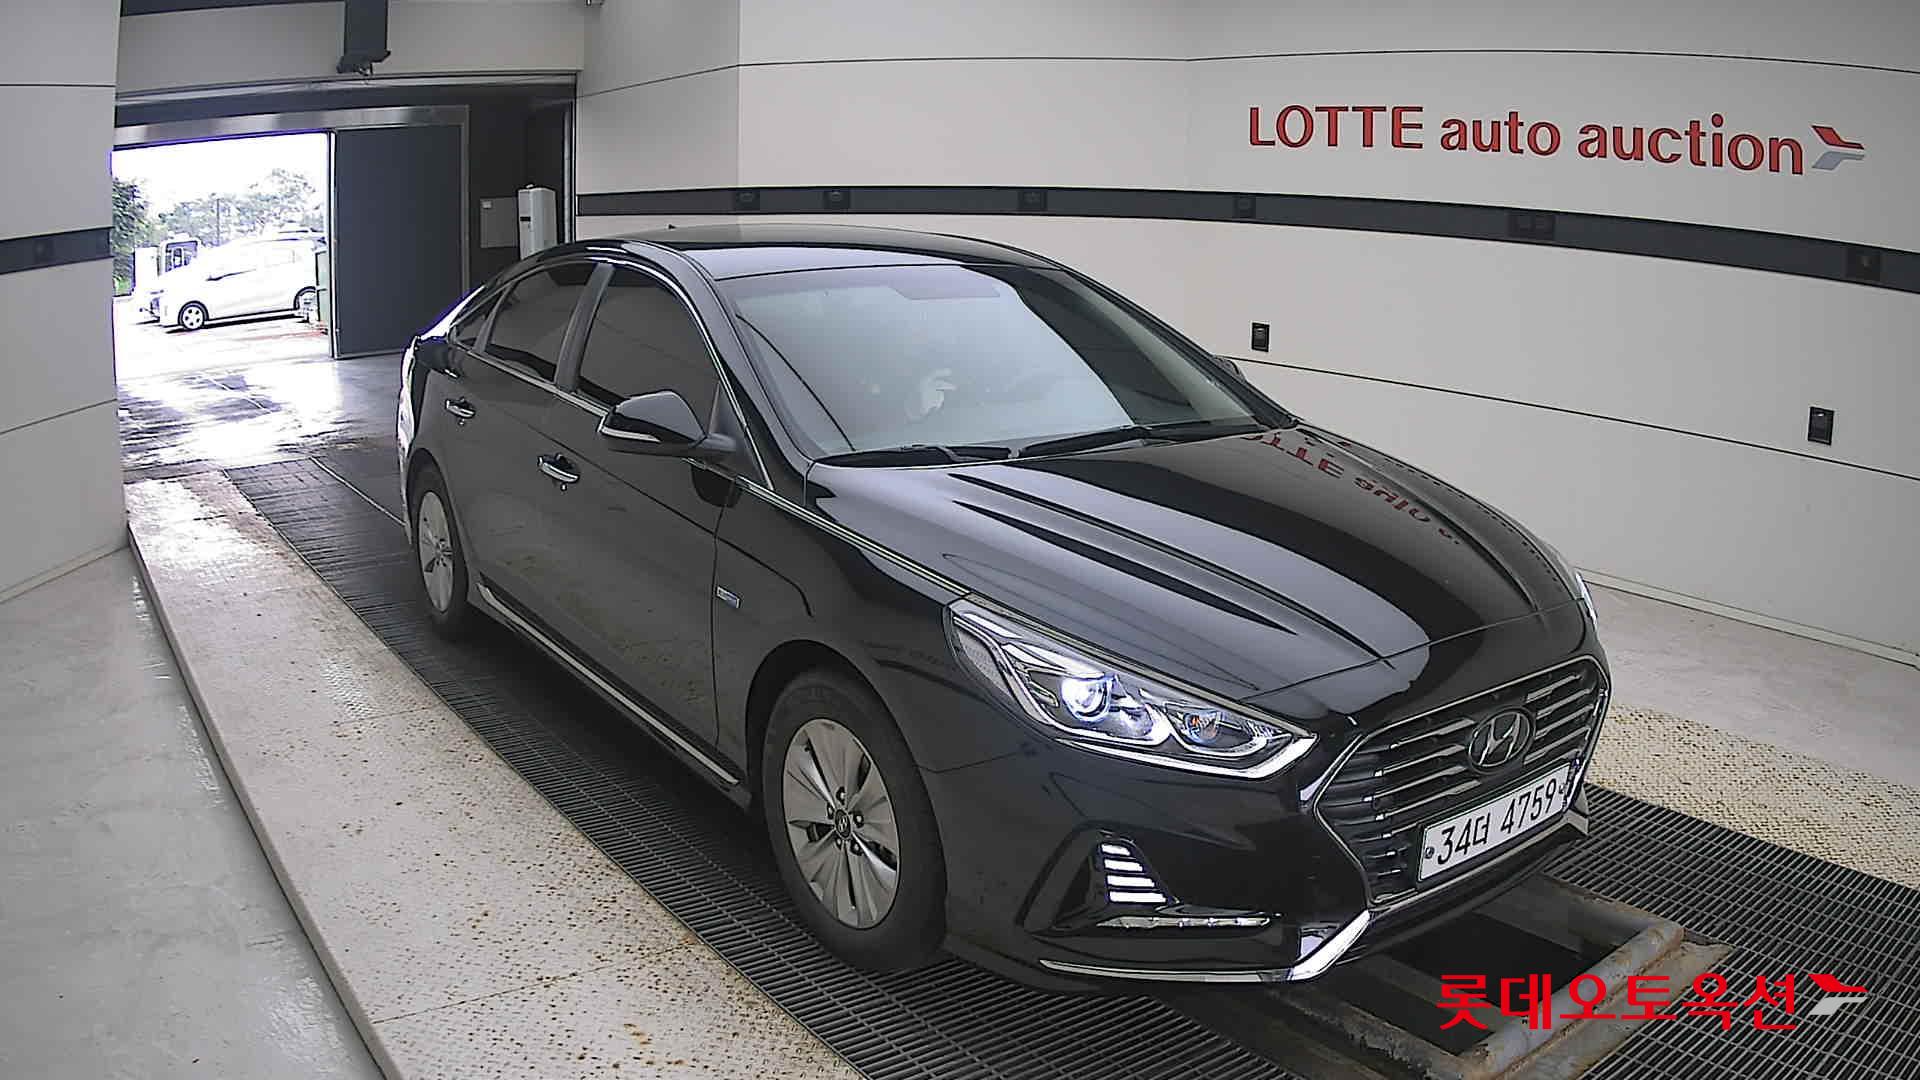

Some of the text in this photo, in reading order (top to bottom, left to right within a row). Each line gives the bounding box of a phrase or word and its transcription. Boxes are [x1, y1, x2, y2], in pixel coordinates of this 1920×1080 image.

[1249, 105, 1805, 175] LOTTE auto auction
[1437, 778, 1557, 865] 34더 4759
